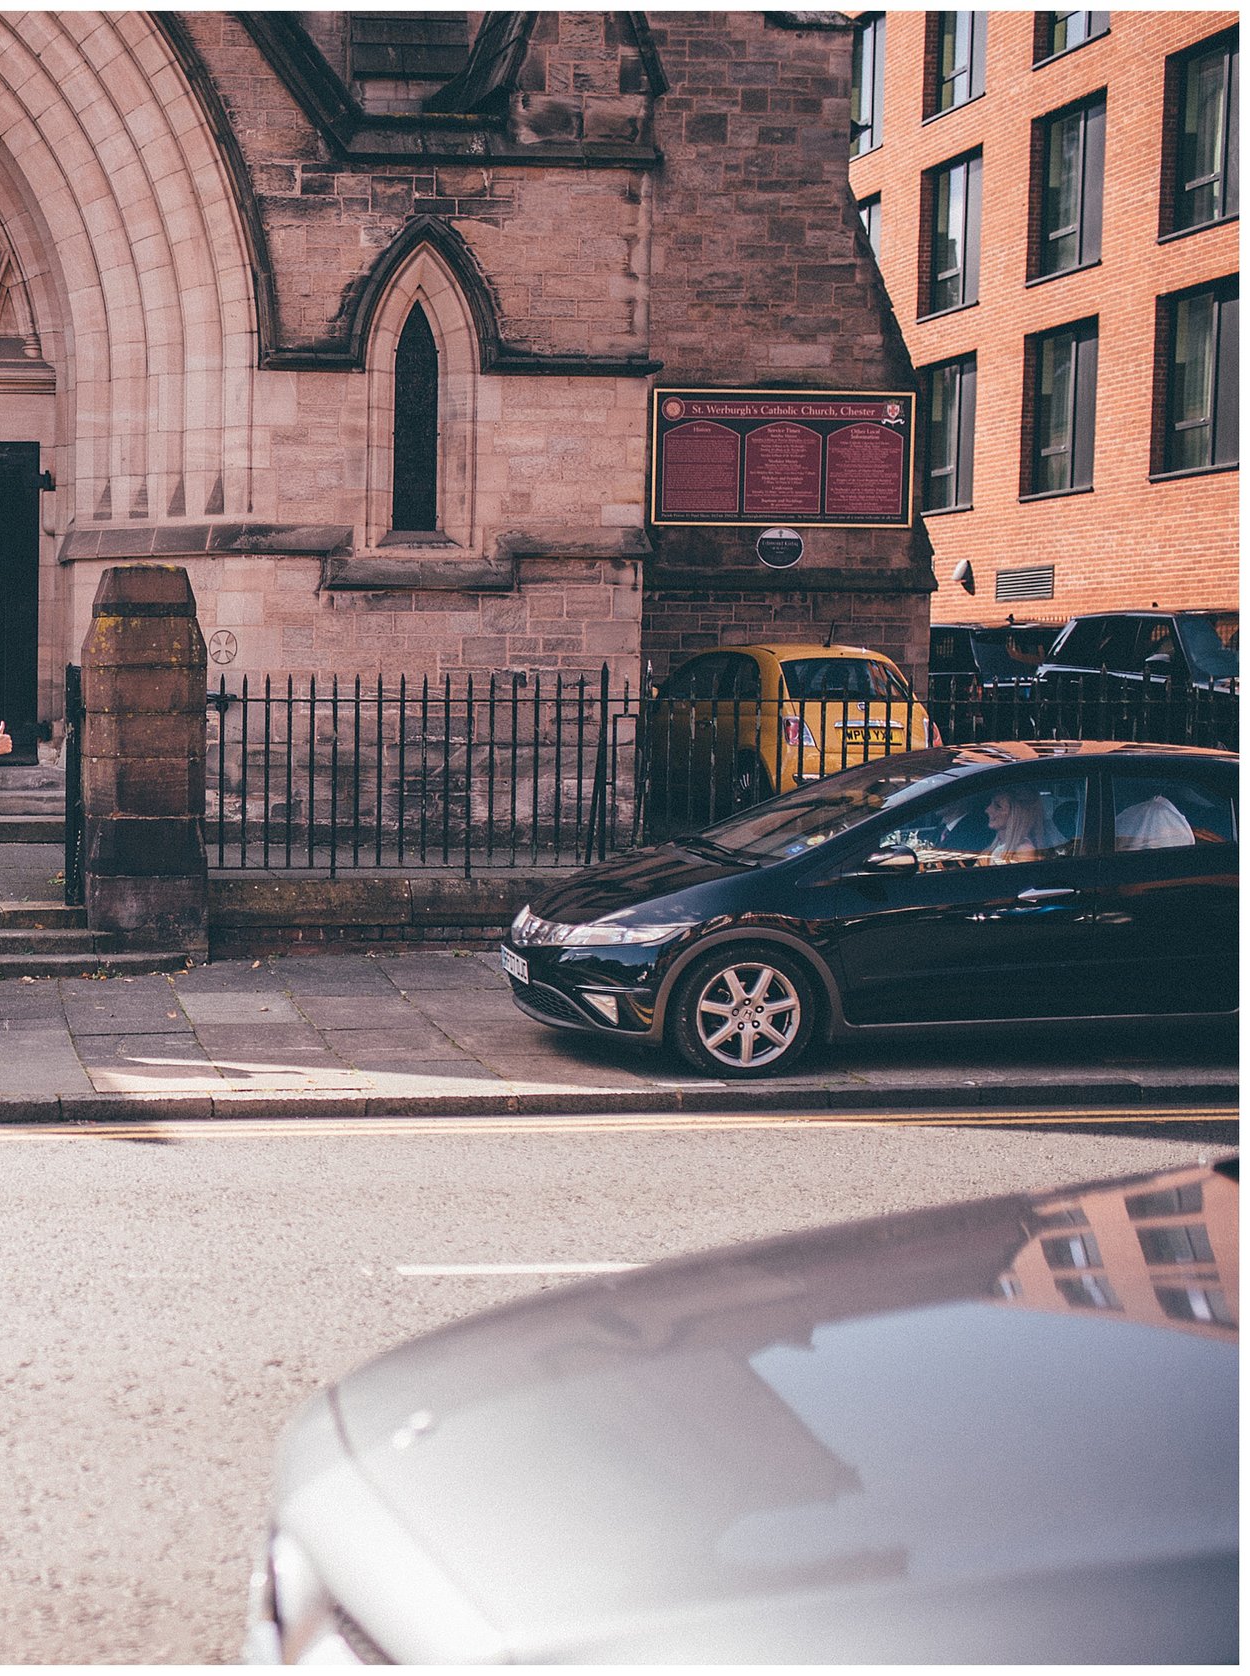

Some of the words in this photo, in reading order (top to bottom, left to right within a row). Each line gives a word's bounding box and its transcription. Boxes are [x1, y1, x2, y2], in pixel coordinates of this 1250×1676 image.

[692, 404, 704, 414] St.
[706, 404, 758, 416] Werburgh's
[760, 405, 798, 415] Catholic
[801, 405, 838, 417] Church,
[840, 406, 876, 416] Chester
